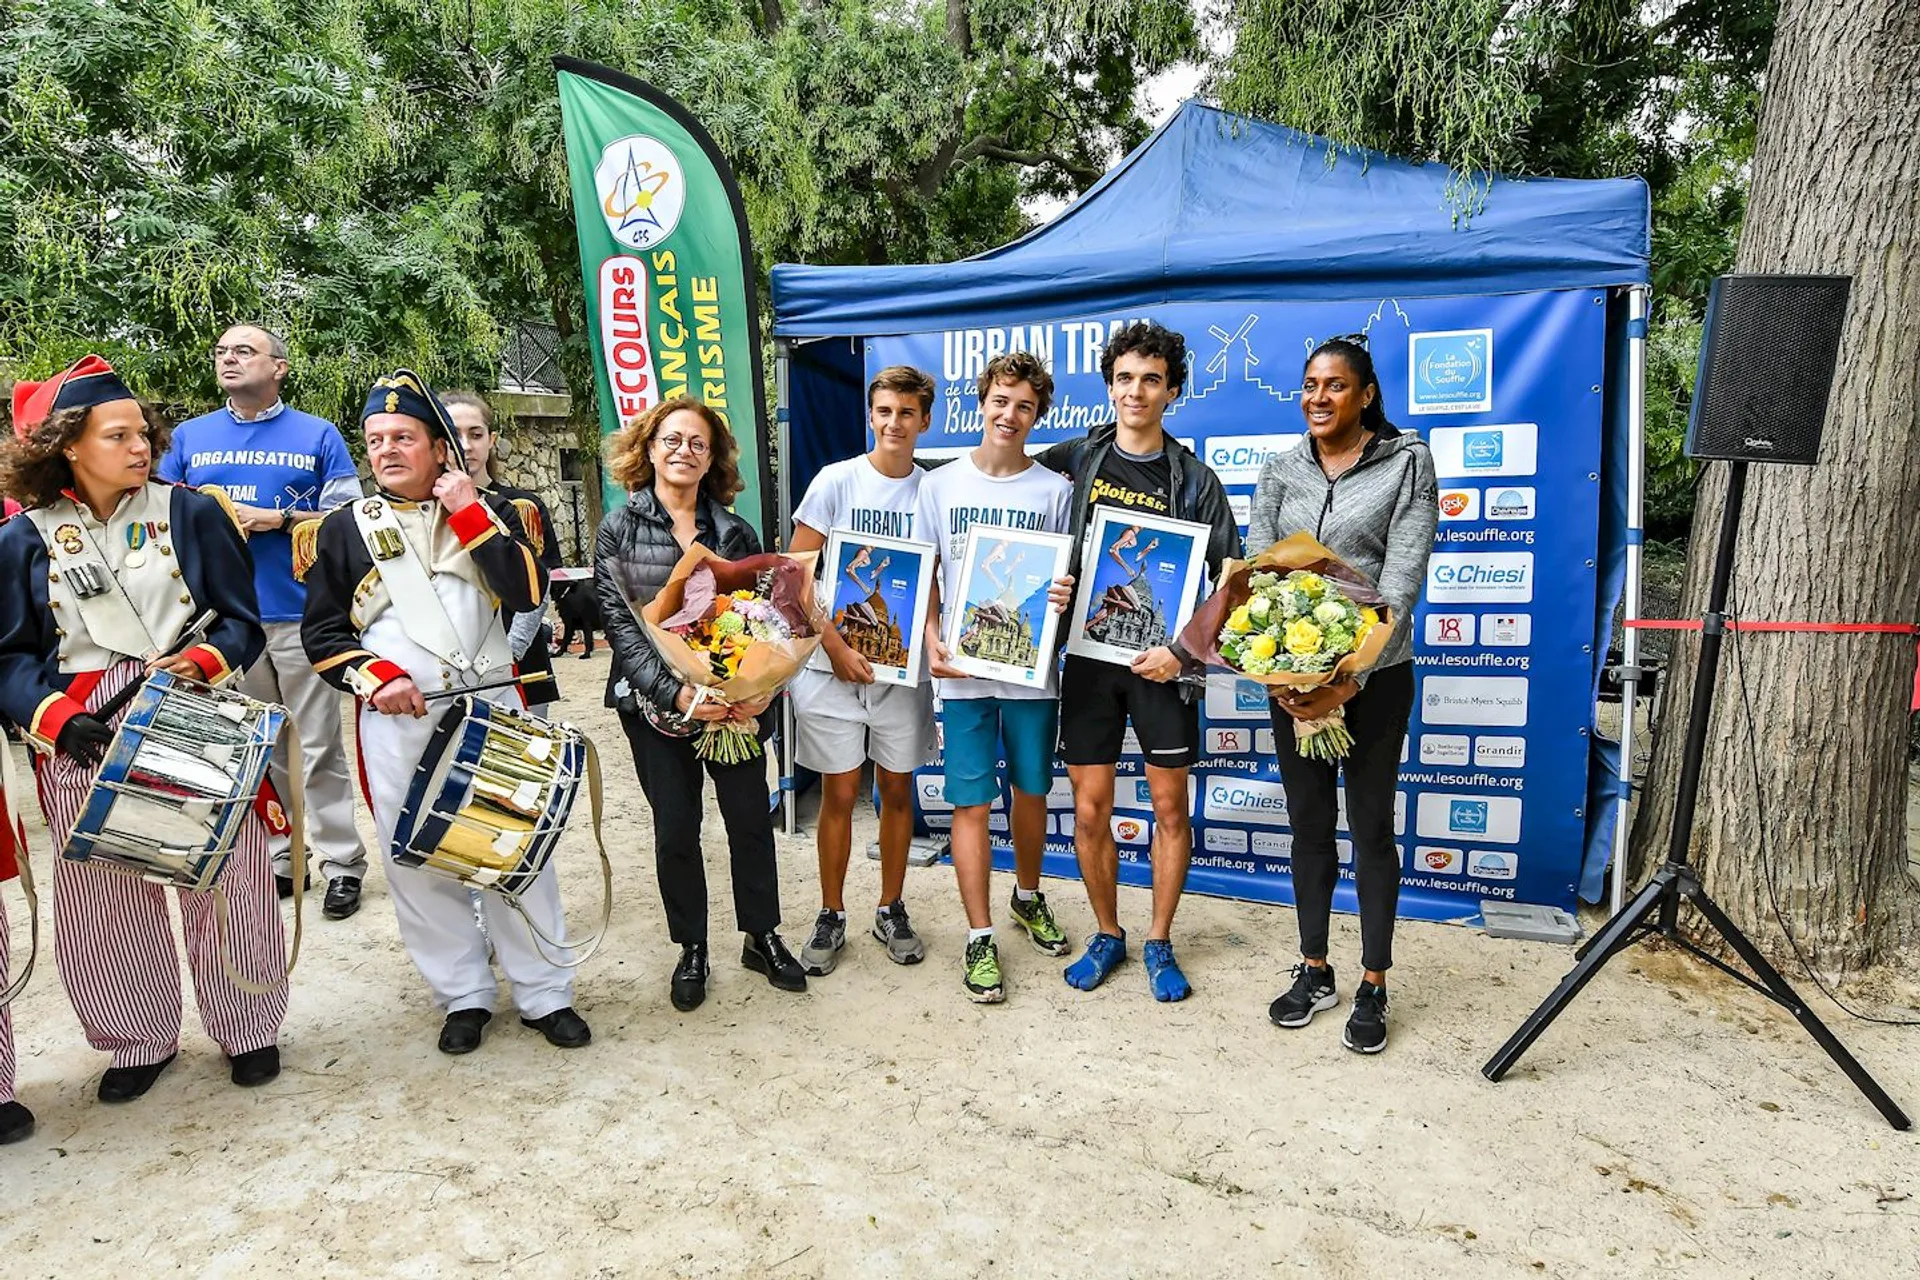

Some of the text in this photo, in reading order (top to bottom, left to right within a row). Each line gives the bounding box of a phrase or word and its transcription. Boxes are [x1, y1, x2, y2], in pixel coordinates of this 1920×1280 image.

[653, 249, 689, 402] ANÇAIS
[612, 266, 649, 425] ECOURS
[691, 276, 731, 431] RISME
[1429, 360, 1472, 369] Fondation
[1445, 353, 1456, 361] La
[945, 379, 979, 397] de la
[1435, 375, 1466, 384] Souffle
[190, 450, 316, 471] ORGANISATION
[1232, 447, 1278, 466] Chie
[226, 484, 258, 502] TRAIL
[1442, 496, 1465, 513] gsk
[851, 507, 903, 538] URBAN
[1434, 528, 1535, 544] w.lesouffle.org
[1457, 565, 1526, 583] Chiesi
[1412, 653, 1530, 670] ww.lesouffle.org
[1471, 697, 1494, 706] Myers
[1477, 744, 1523, 755] Grandir
[1397, 772, 1524, 791] www.lesouffle.org
[1230, 789, 1287, 809] Chies
[1118, 822, 1137, 836] gsk
[1253, 838, 1291, 849] Grandi
[1191, 856, 1256, 873] souffle.org
[1427, 855, 1449, 866] gsk
